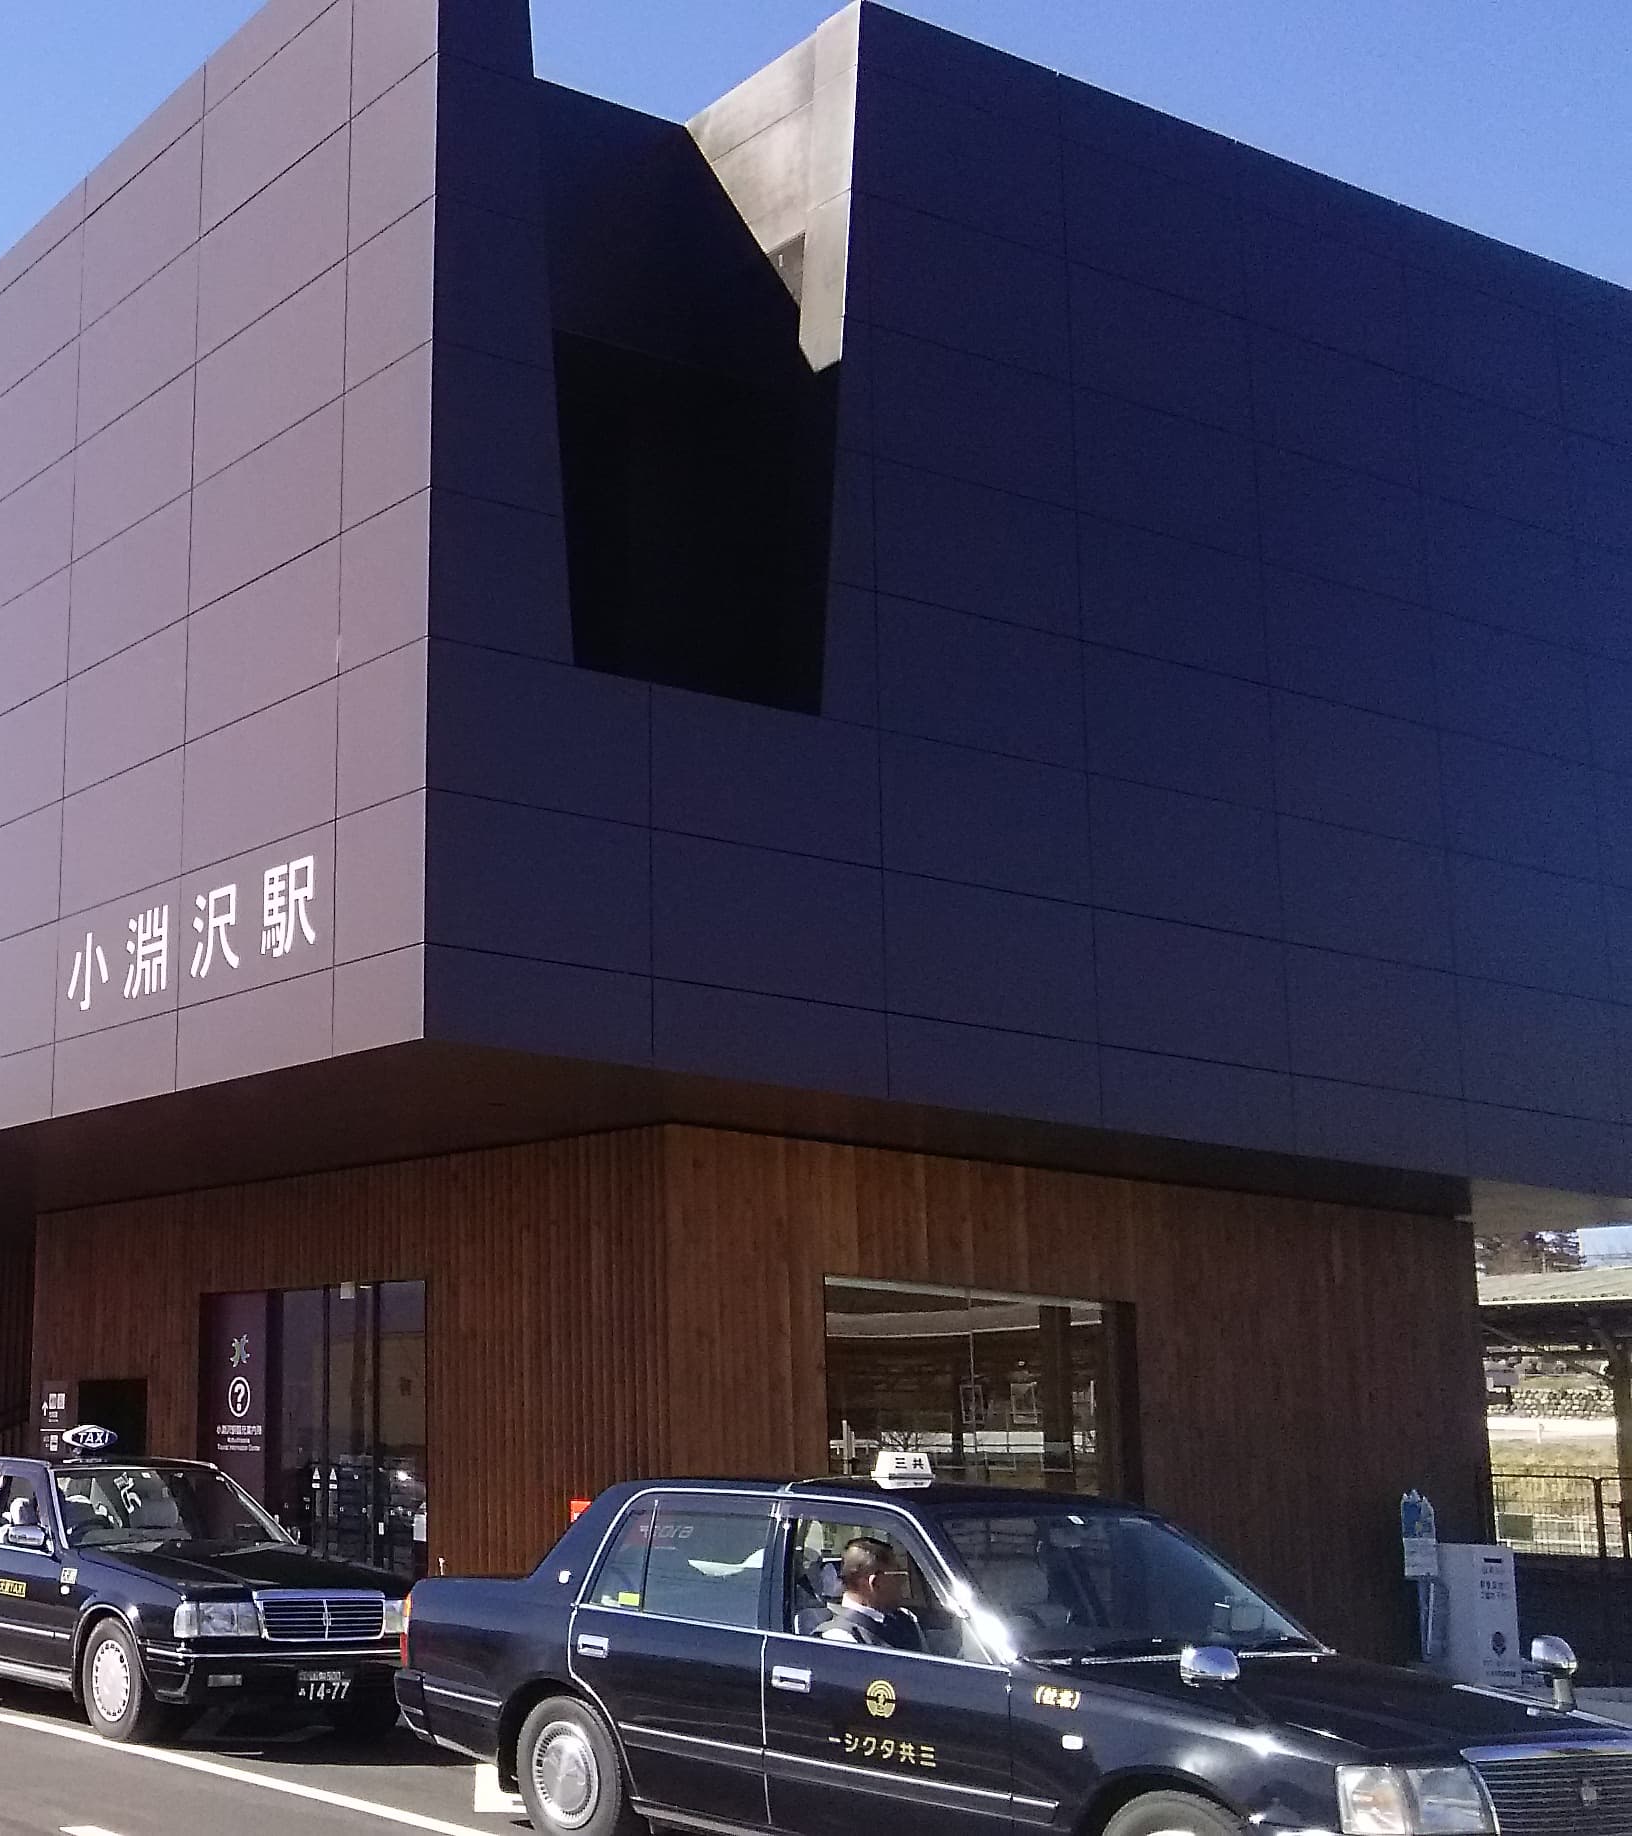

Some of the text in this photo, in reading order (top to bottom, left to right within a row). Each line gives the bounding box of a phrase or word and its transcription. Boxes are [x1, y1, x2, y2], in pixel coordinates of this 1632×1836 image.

[67, 855, 316, 1011] 小淵沢駅
[78, 1432, 109, 1443] TAXI
[895, 1457, 924, 1469] 三共
